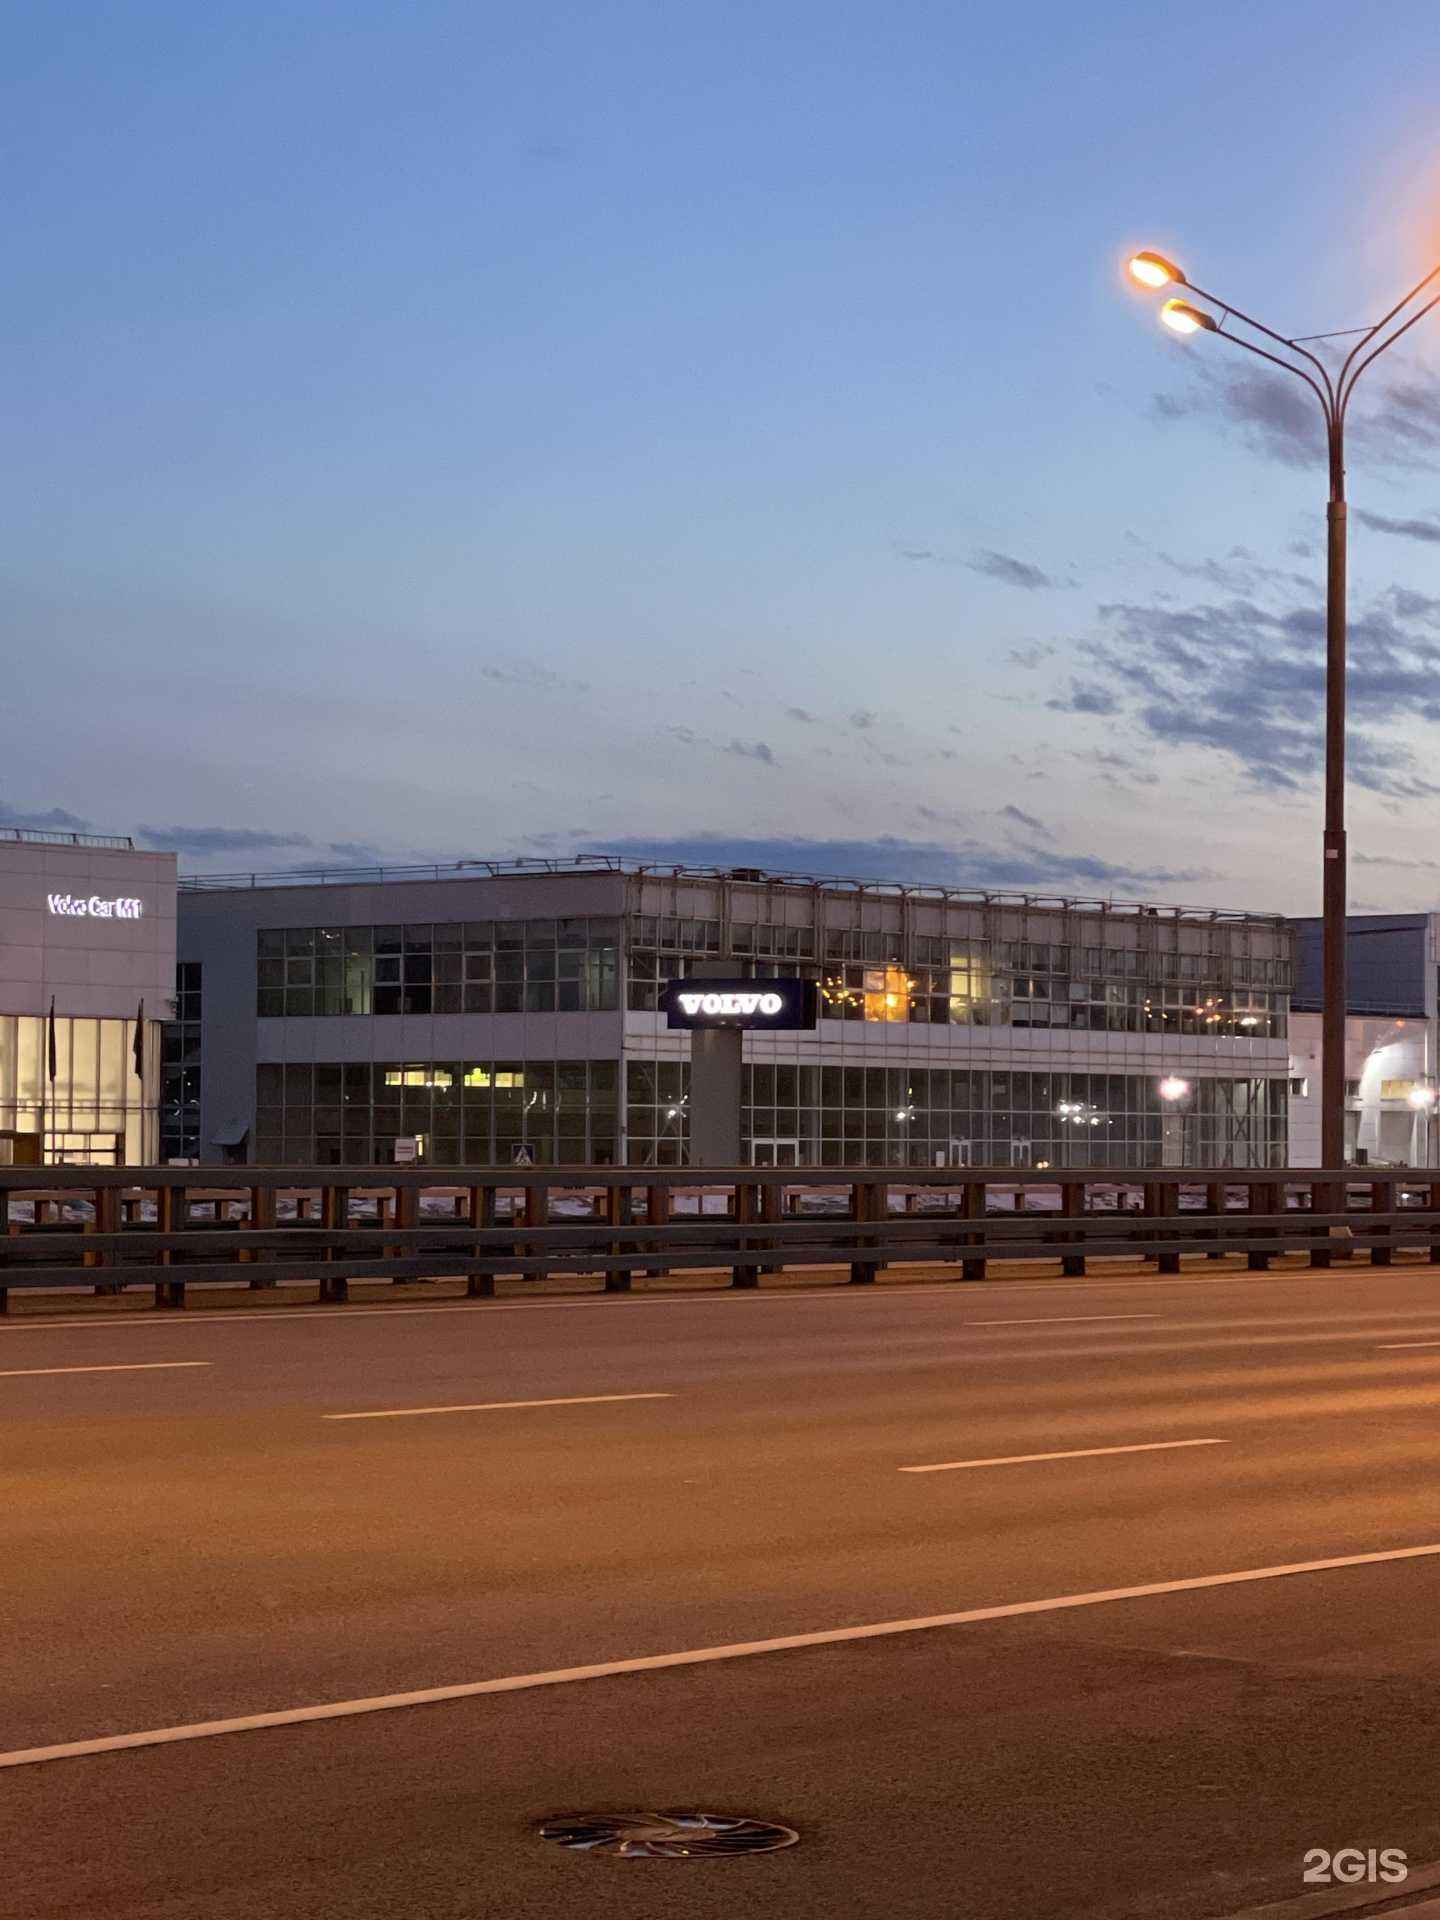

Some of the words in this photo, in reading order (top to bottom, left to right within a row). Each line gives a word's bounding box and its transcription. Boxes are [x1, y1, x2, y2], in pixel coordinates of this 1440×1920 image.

[47, 894, 87, 916] Volvo
[88, 896, 114, 917] Car
[678, 993, 782, 1015] VOLVO
